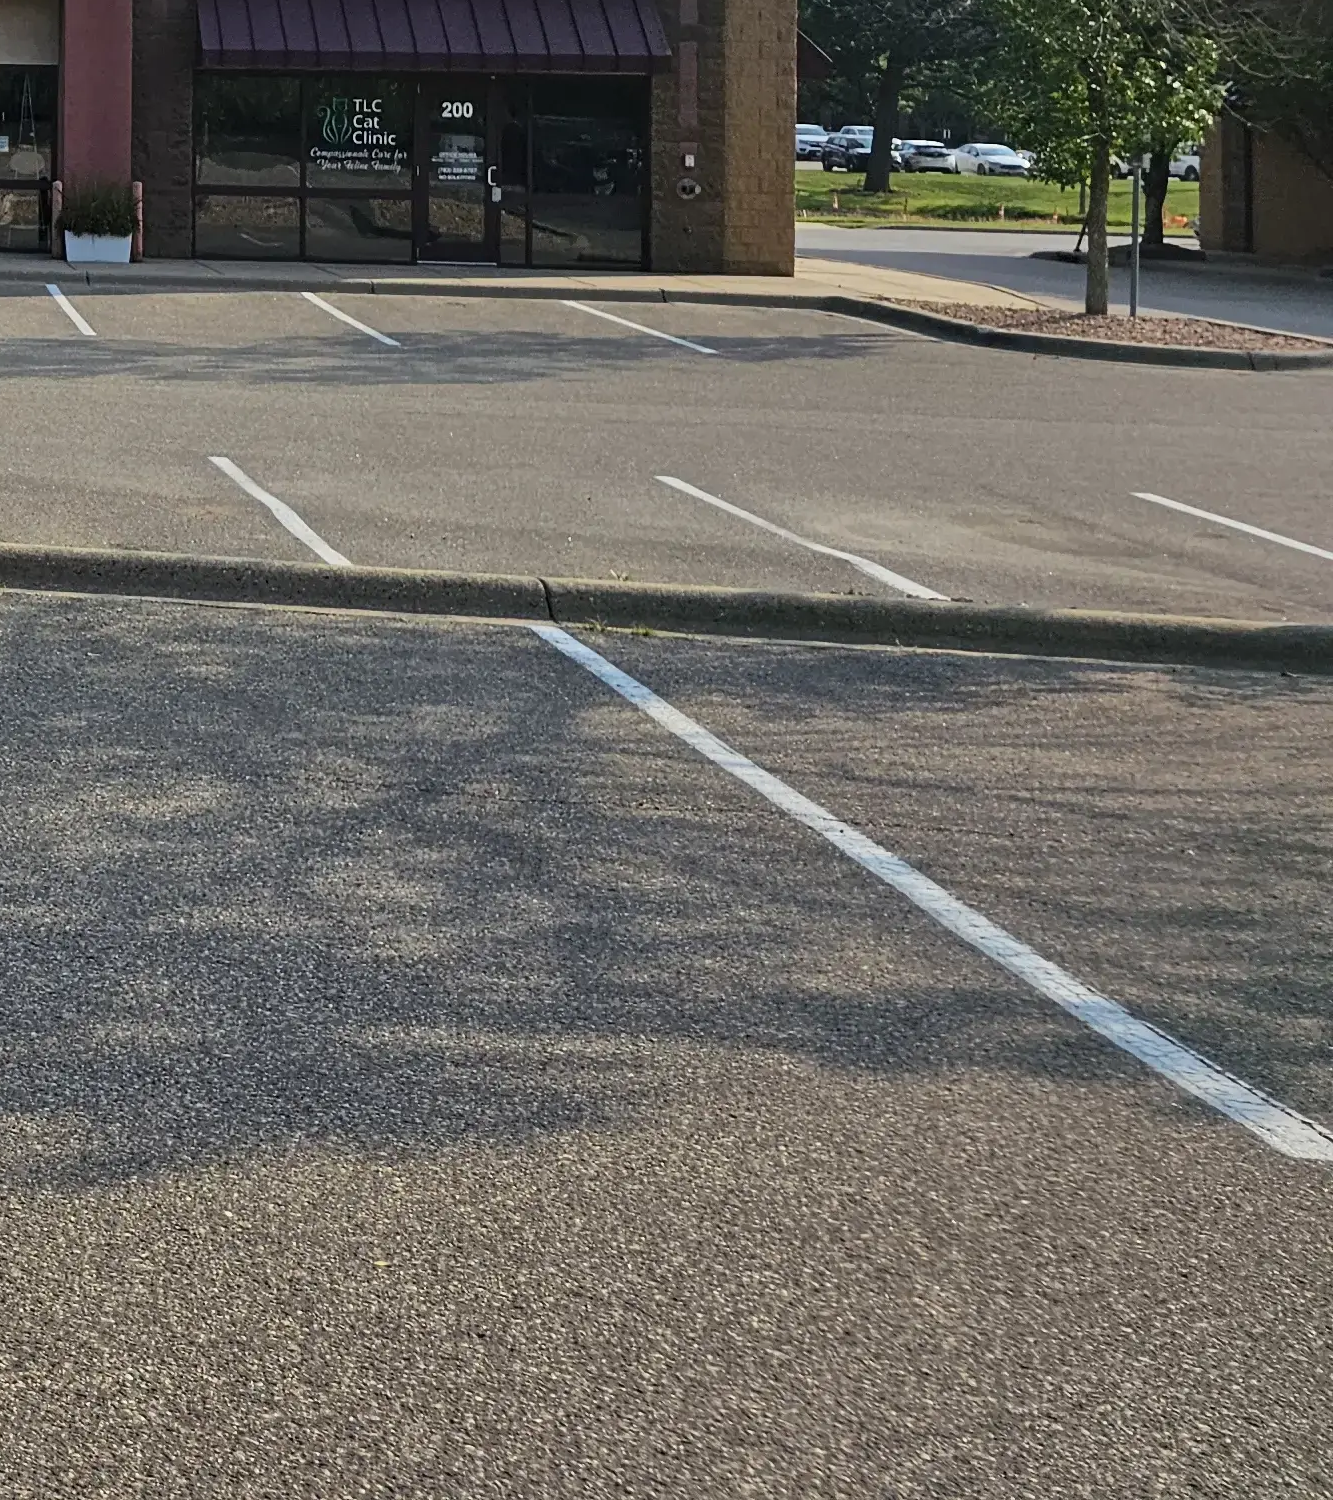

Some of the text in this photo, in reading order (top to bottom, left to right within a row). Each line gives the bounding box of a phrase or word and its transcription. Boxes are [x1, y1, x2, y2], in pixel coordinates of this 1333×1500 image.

[353, 99, 382, 113] TLC
[441, 102, 474, 118] 200
[353, 114, 380, 129] Cat
[352, 131, 397, 146] Clinic
[372, 148, 392, 159] Care
[393, 148, 408, 161] for
[316, 159, 402, 175] Your Feline Family
